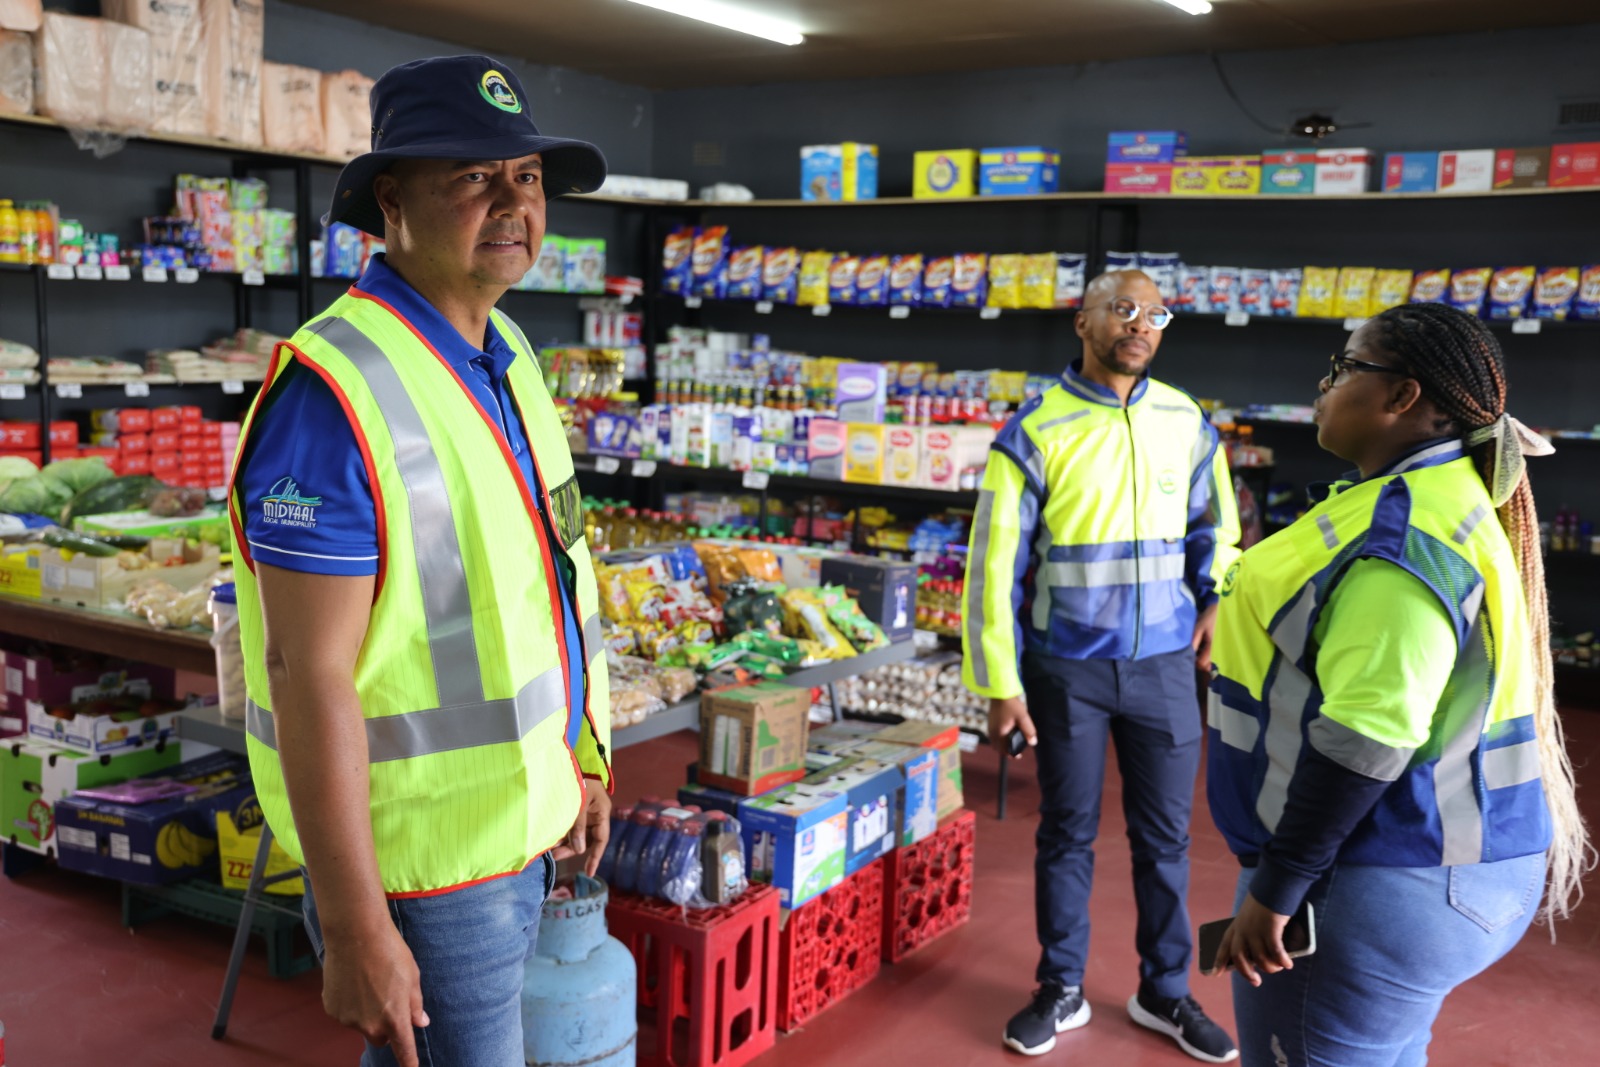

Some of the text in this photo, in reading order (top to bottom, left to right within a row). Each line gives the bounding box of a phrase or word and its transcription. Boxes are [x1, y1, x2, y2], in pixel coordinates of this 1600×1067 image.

[263, 502, 316, 521] MIDVAAL
[263, 516, 316, 528] LOCAL MUNICIPALITY
